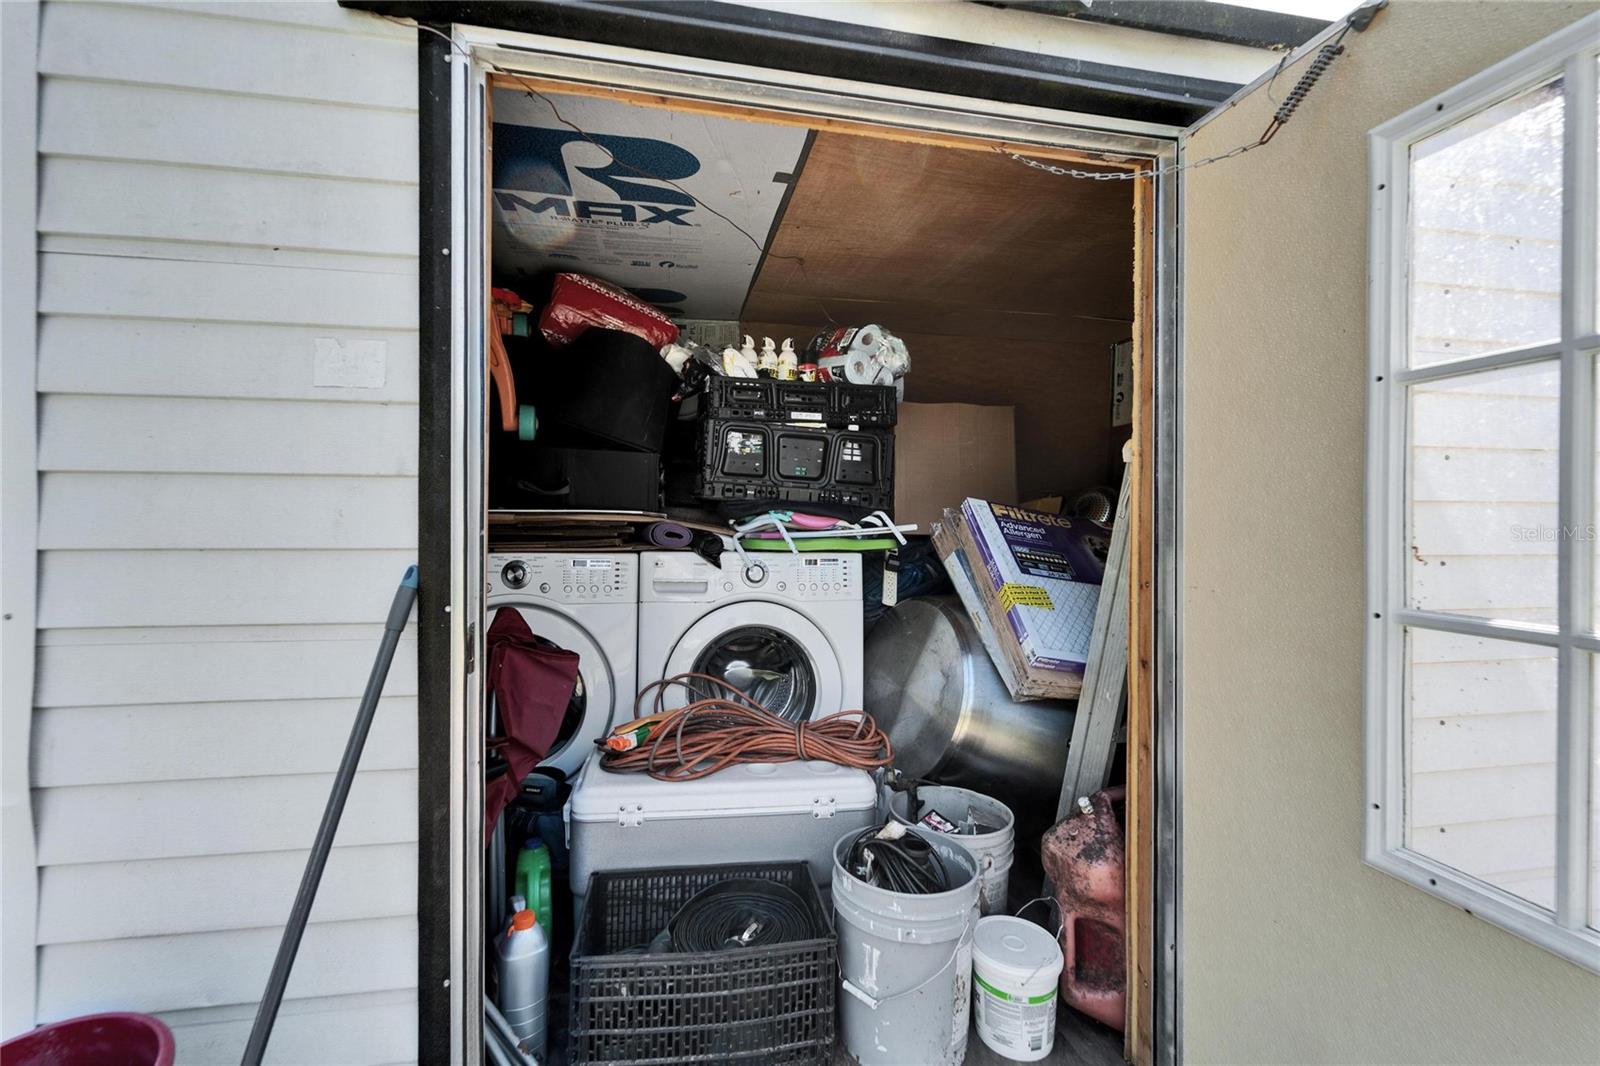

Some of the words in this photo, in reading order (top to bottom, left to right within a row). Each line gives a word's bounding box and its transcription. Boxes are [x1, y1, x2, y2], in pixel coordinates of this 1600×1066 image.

[494, 192, 697, 227] MAX
[991, 503, 1072, 529] Filtrete
[1001, 521, 1046, 534] Advanced
[1004, 528, 1043, 540] Allergen
